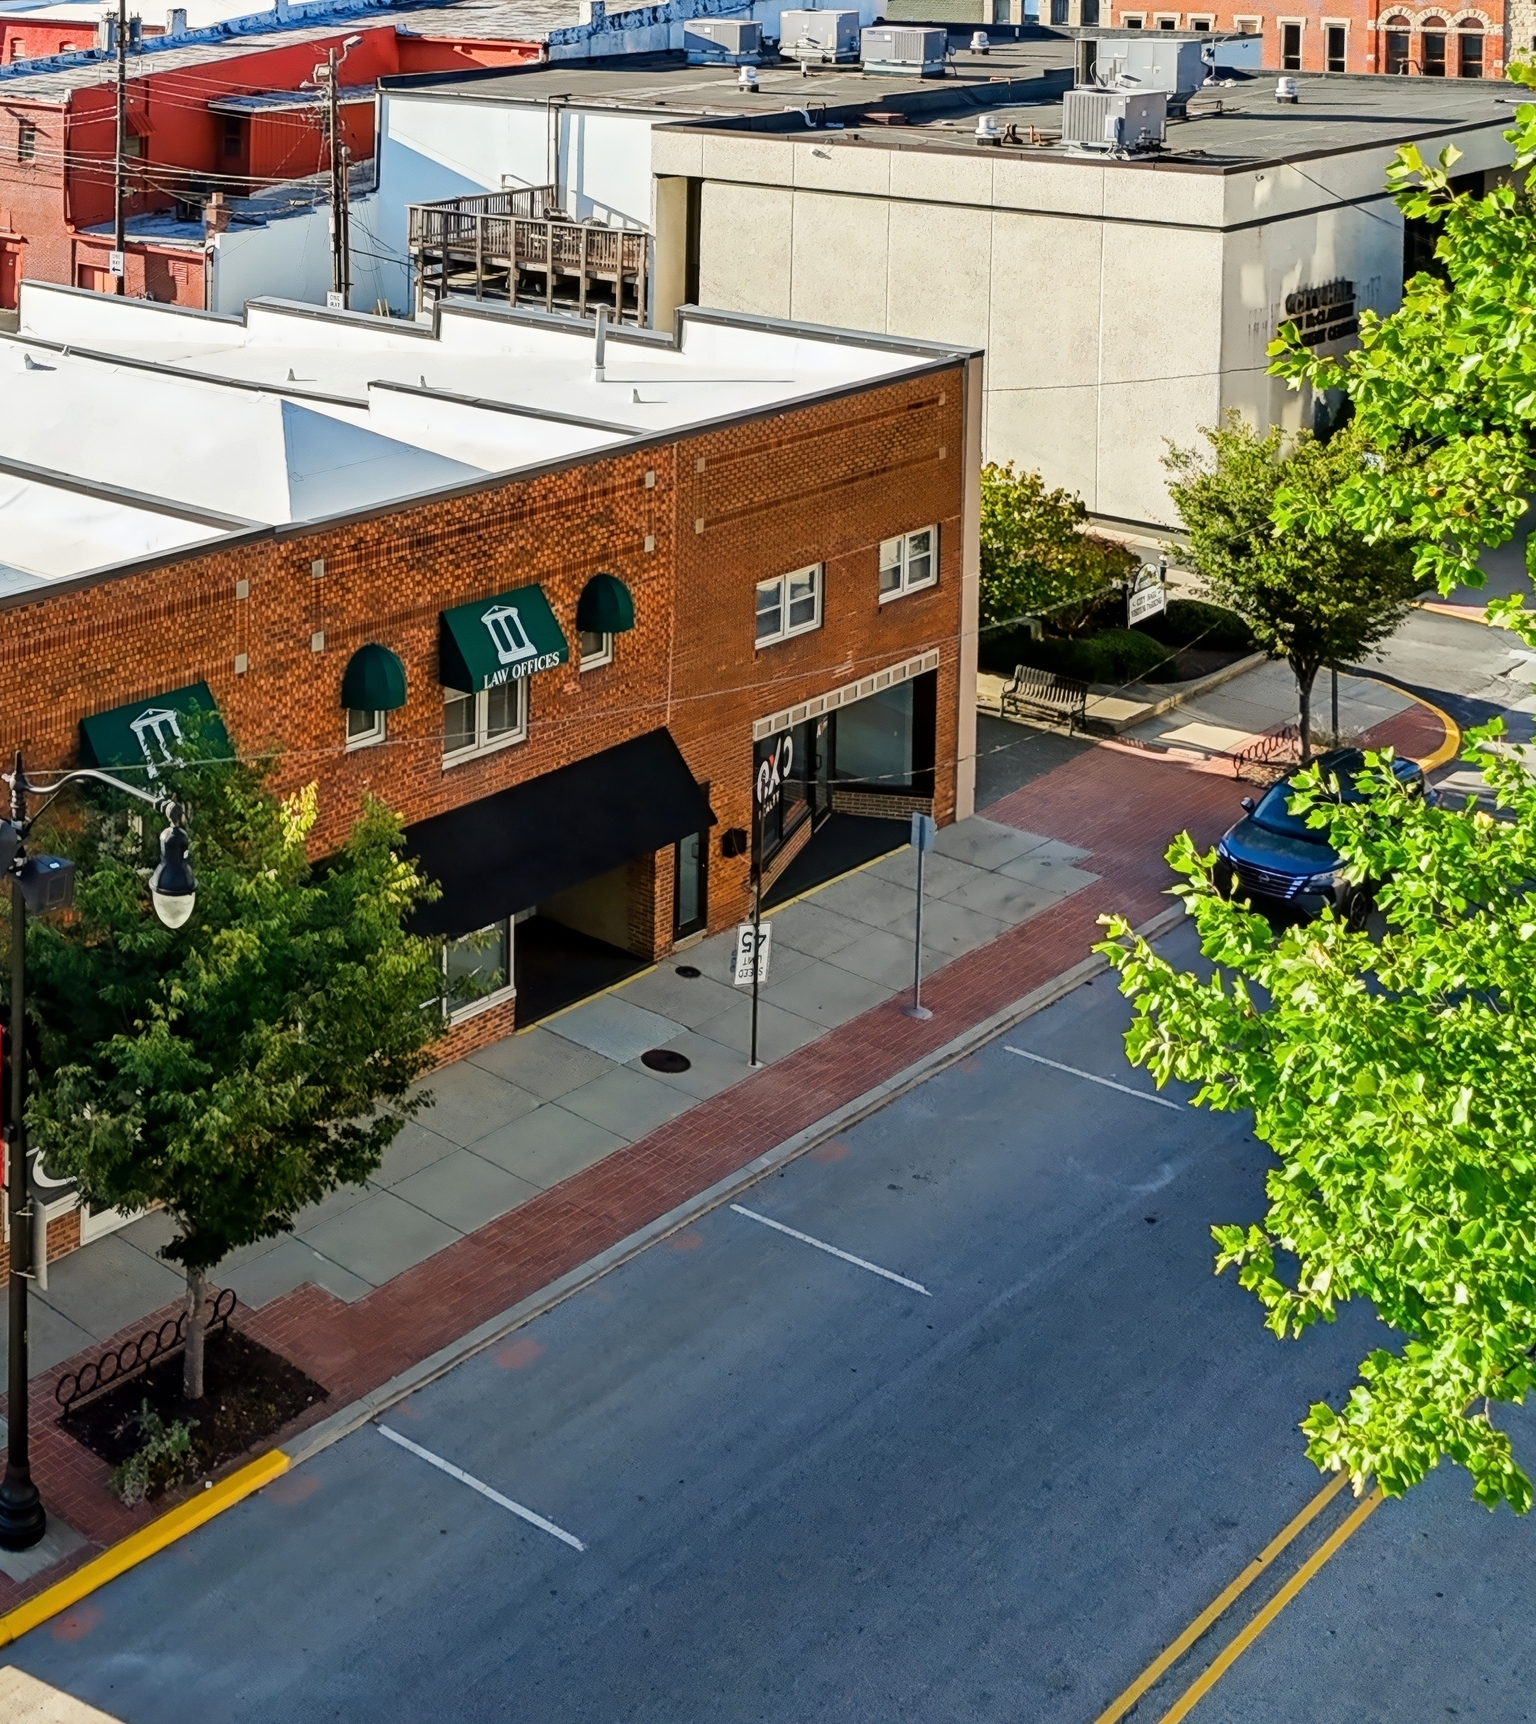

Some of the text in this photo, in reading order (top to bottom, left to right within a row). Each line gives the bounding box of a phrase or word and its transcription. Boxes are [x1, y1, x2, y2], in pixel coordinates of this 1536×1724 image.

[484, 651, 560, 689] LAW OFFICES
[741, 931, 767, 954] 45
[737, 966, 764, 979] SEED
